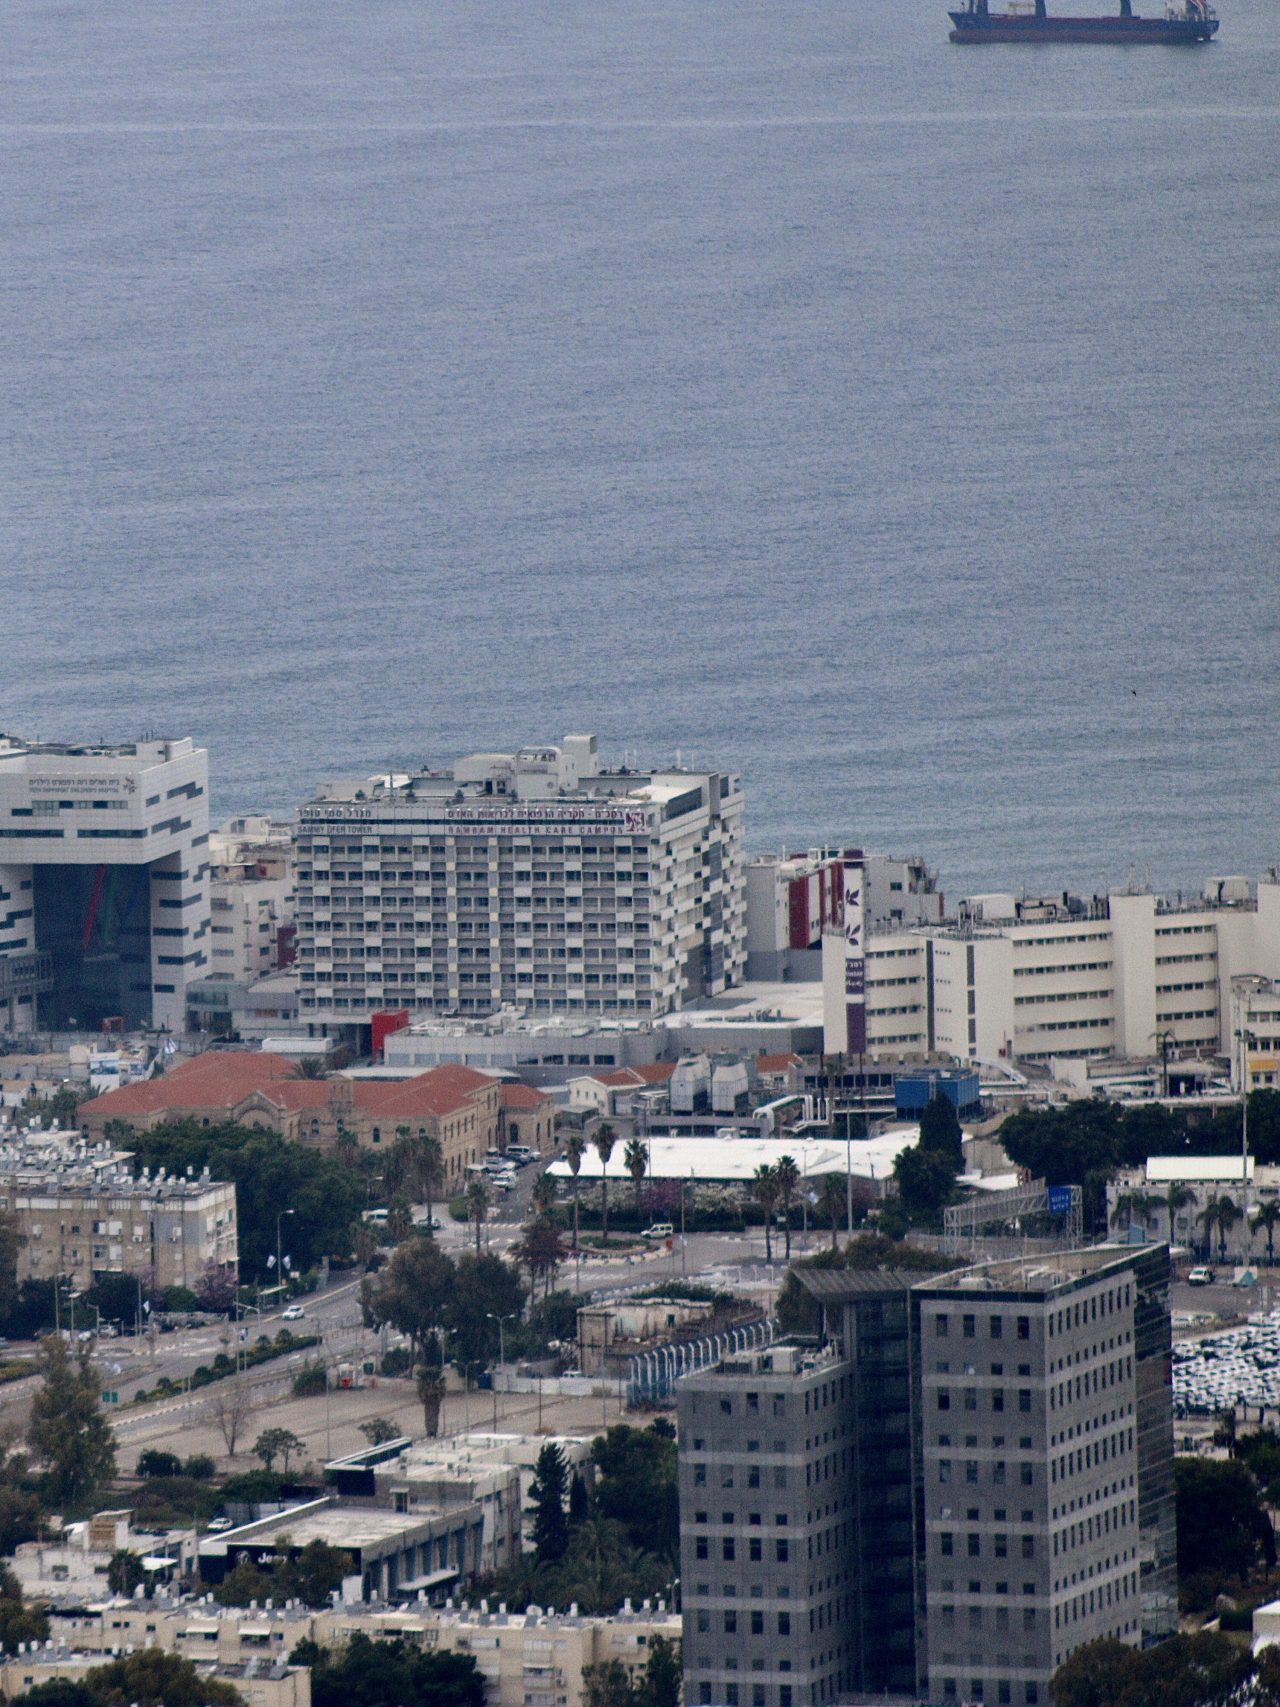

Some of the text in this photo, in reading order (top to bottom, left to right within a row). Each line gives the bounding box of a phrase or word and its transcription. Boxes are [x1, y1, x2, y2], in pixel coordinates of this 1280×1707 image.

[347, 808, 371, 817] מגדל
[545, 826, 573, 834] CARE
[579, 826, 623, 834] CAMPUS
